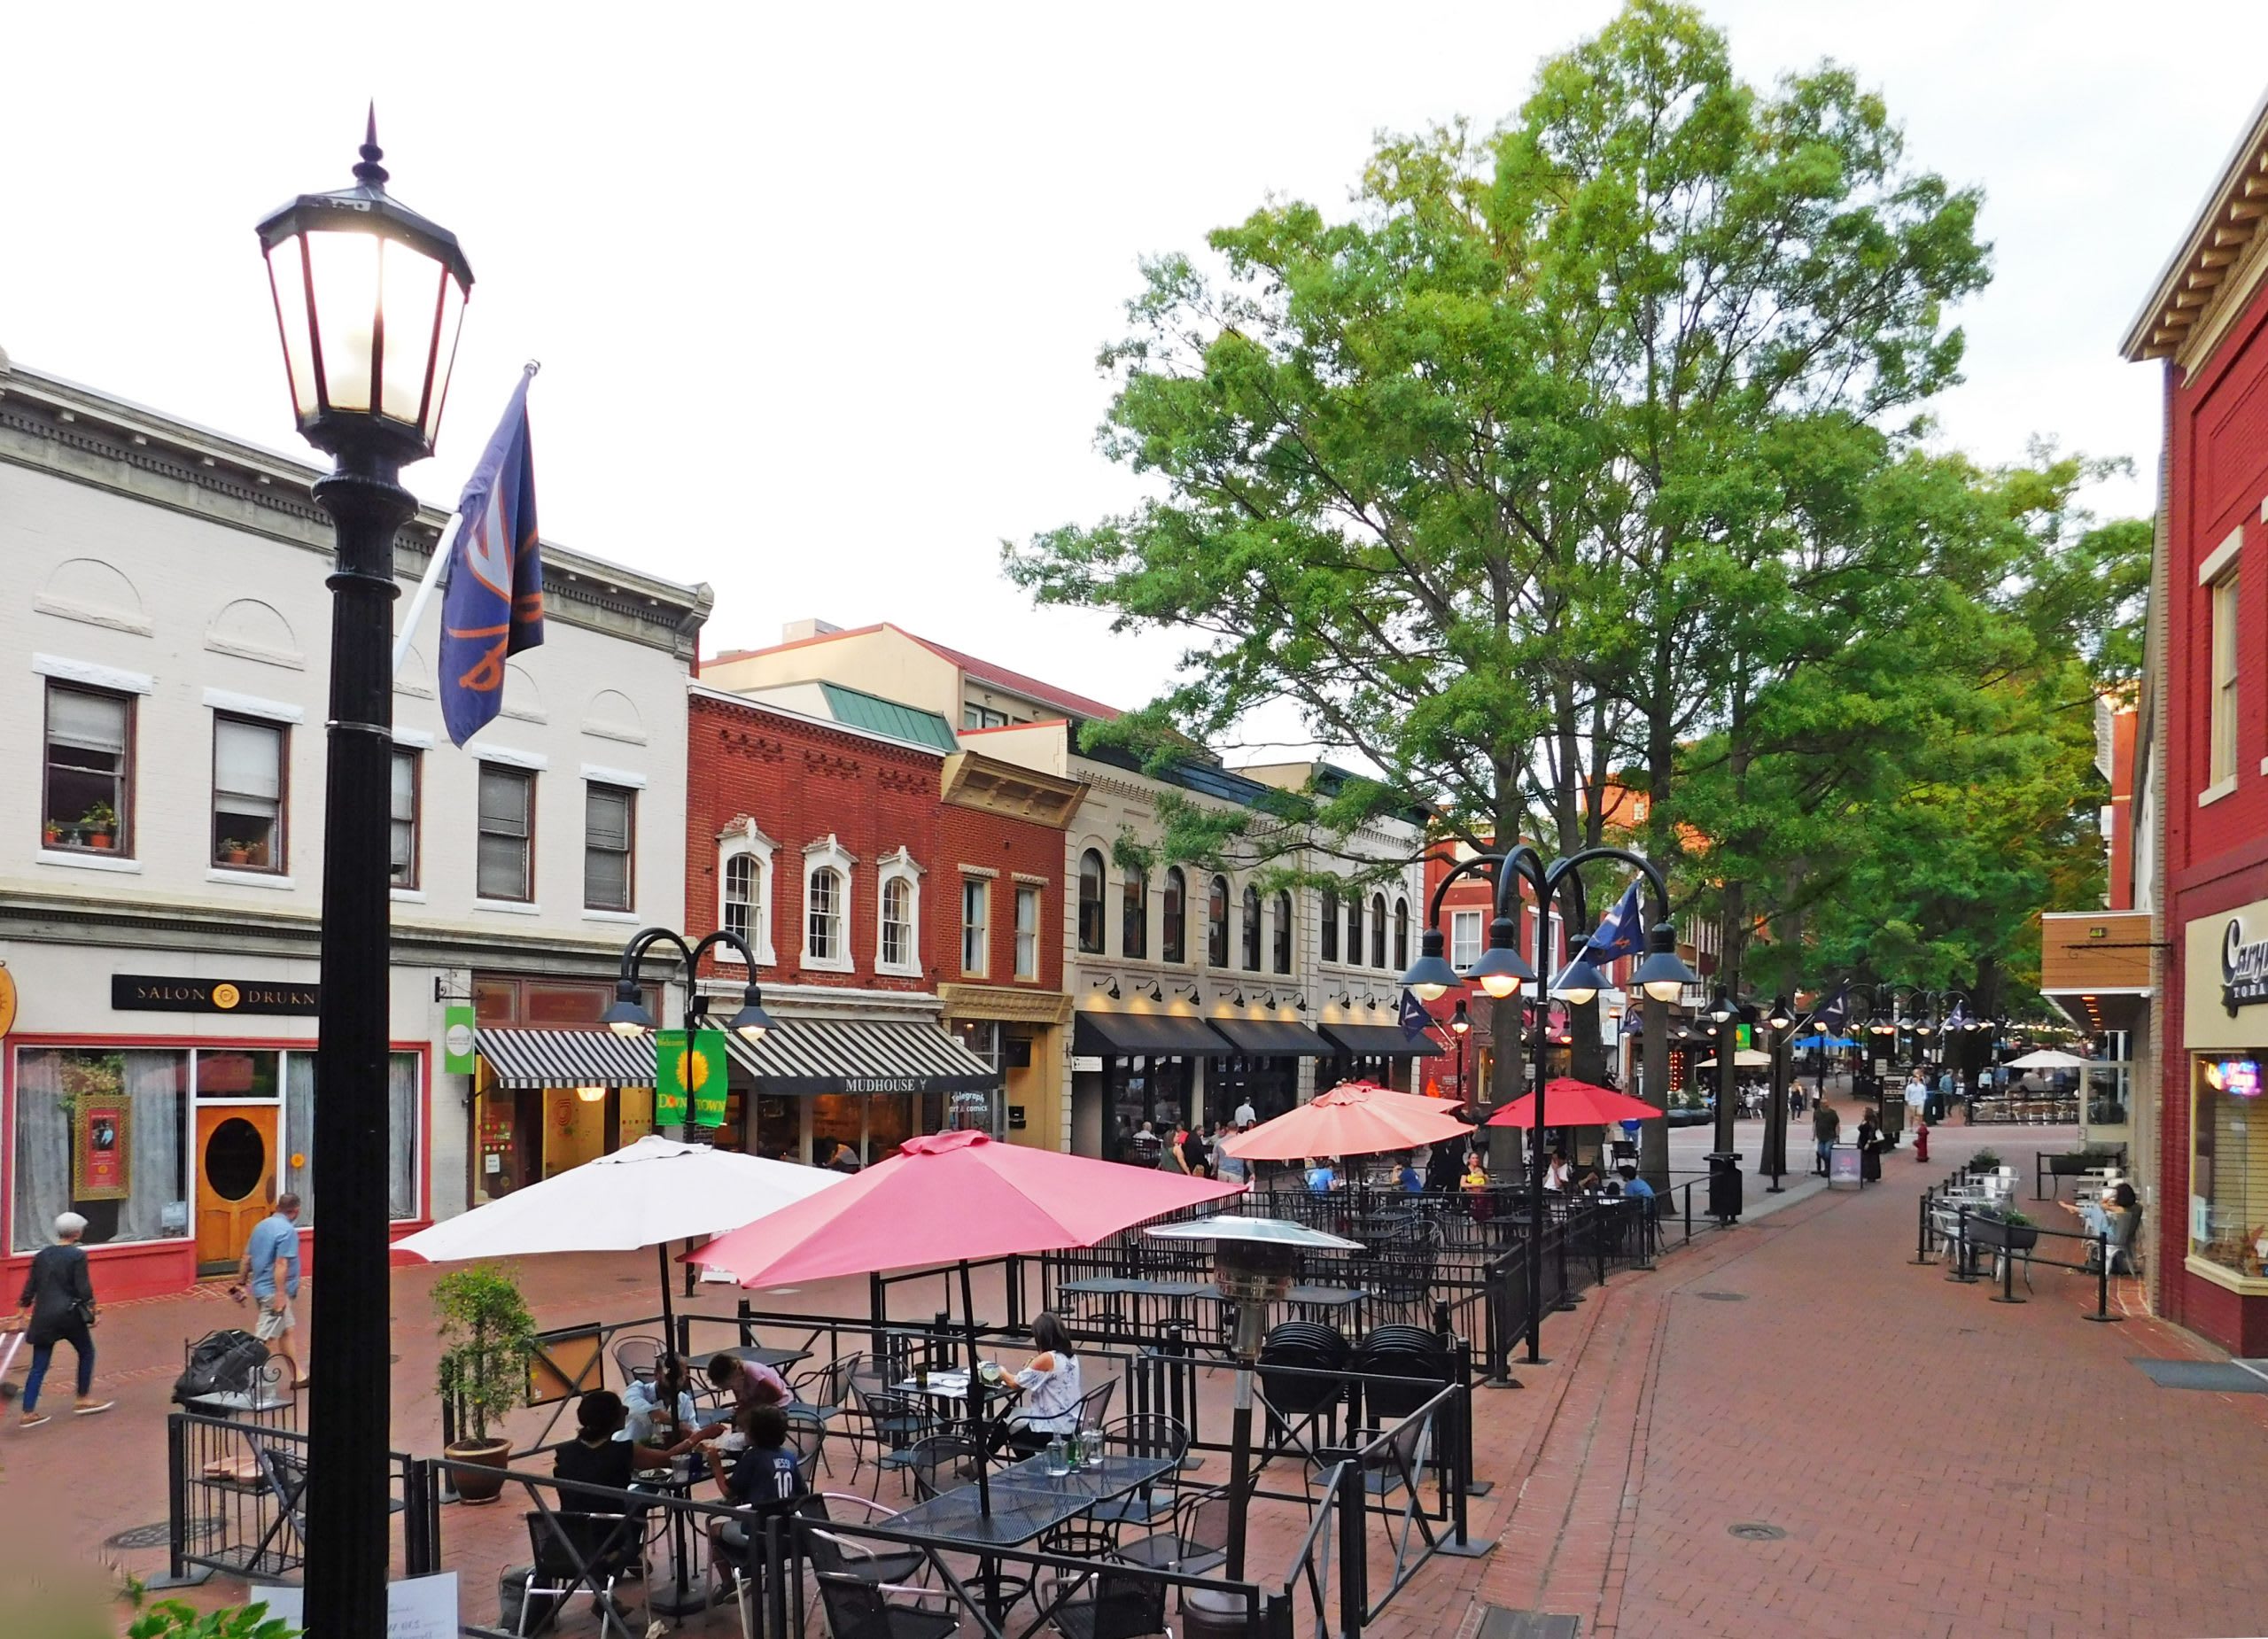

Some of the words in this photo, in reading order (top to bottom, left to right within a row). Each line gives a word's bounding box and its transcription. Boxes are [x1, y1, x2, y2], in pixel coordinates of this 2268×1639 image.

[137, 986, 206, 1000] SALON
[845, 1078, 915, 1092] MUDHOUSE
[773, 1471, 793, 1499] 10
